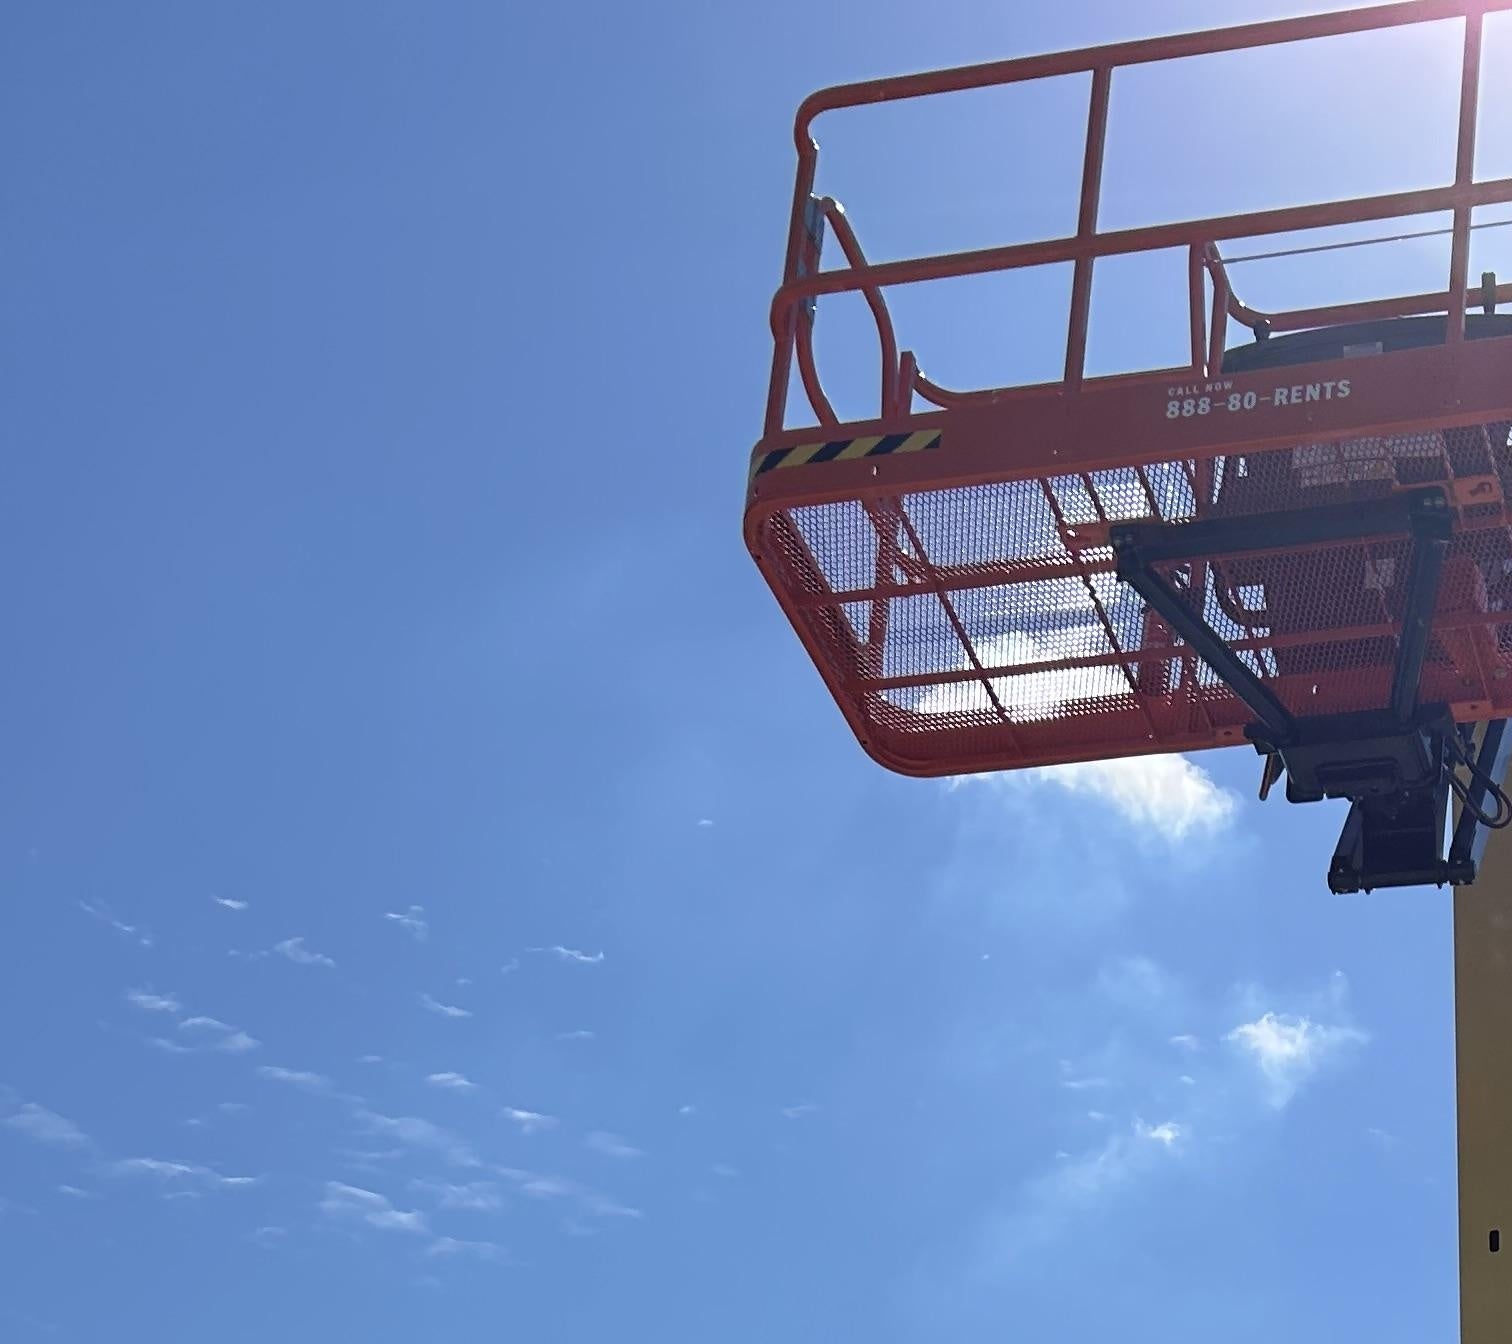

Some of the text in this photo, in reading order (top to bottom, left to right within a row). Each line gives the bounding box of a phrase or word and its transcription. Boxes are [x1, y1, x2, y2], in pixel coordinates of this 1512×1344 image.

[1166, 379, 1351, 419] 888-80-RENTS
[1168, 381, 1234, 397] CALL NOW
